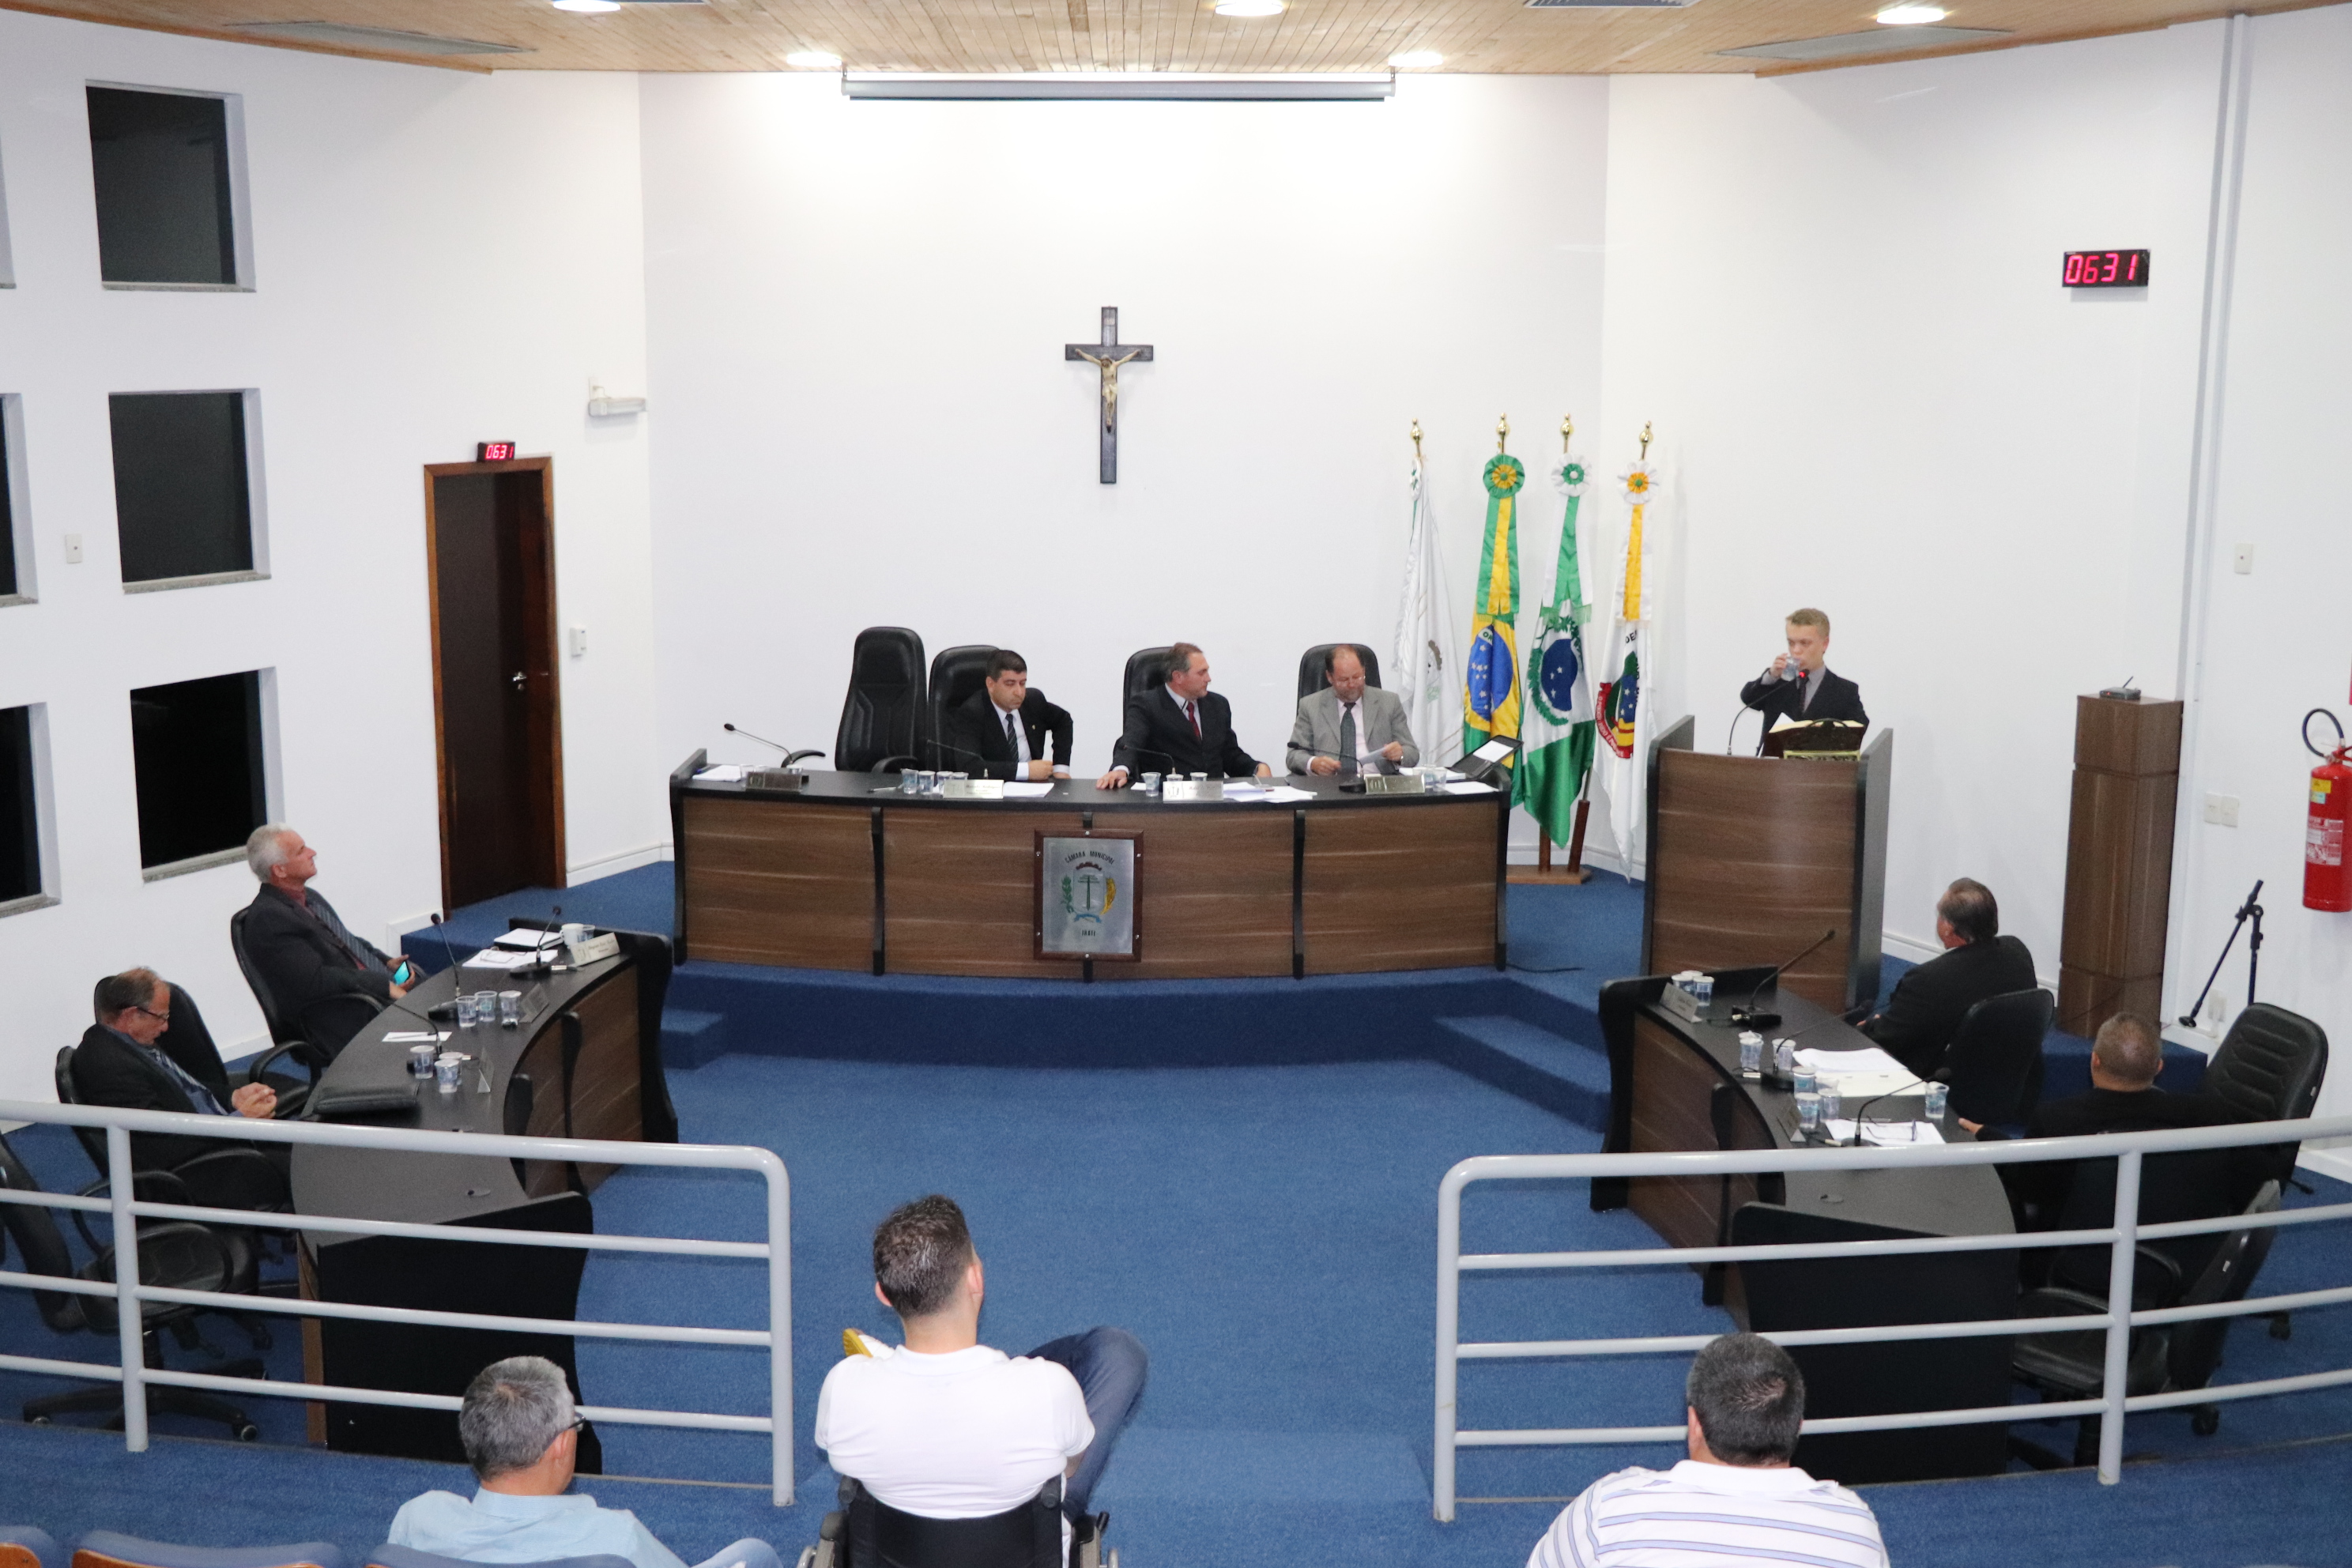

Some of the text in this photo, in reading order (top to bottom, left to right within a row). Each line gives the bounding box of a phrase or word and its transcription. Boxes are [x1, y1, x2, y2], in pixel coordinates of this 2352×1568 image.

[2064, 253, 2139, 284] 0631
[485, 443, 514, 459] 0631
[1090, 850, 1114, 865] MUNICIPAL
